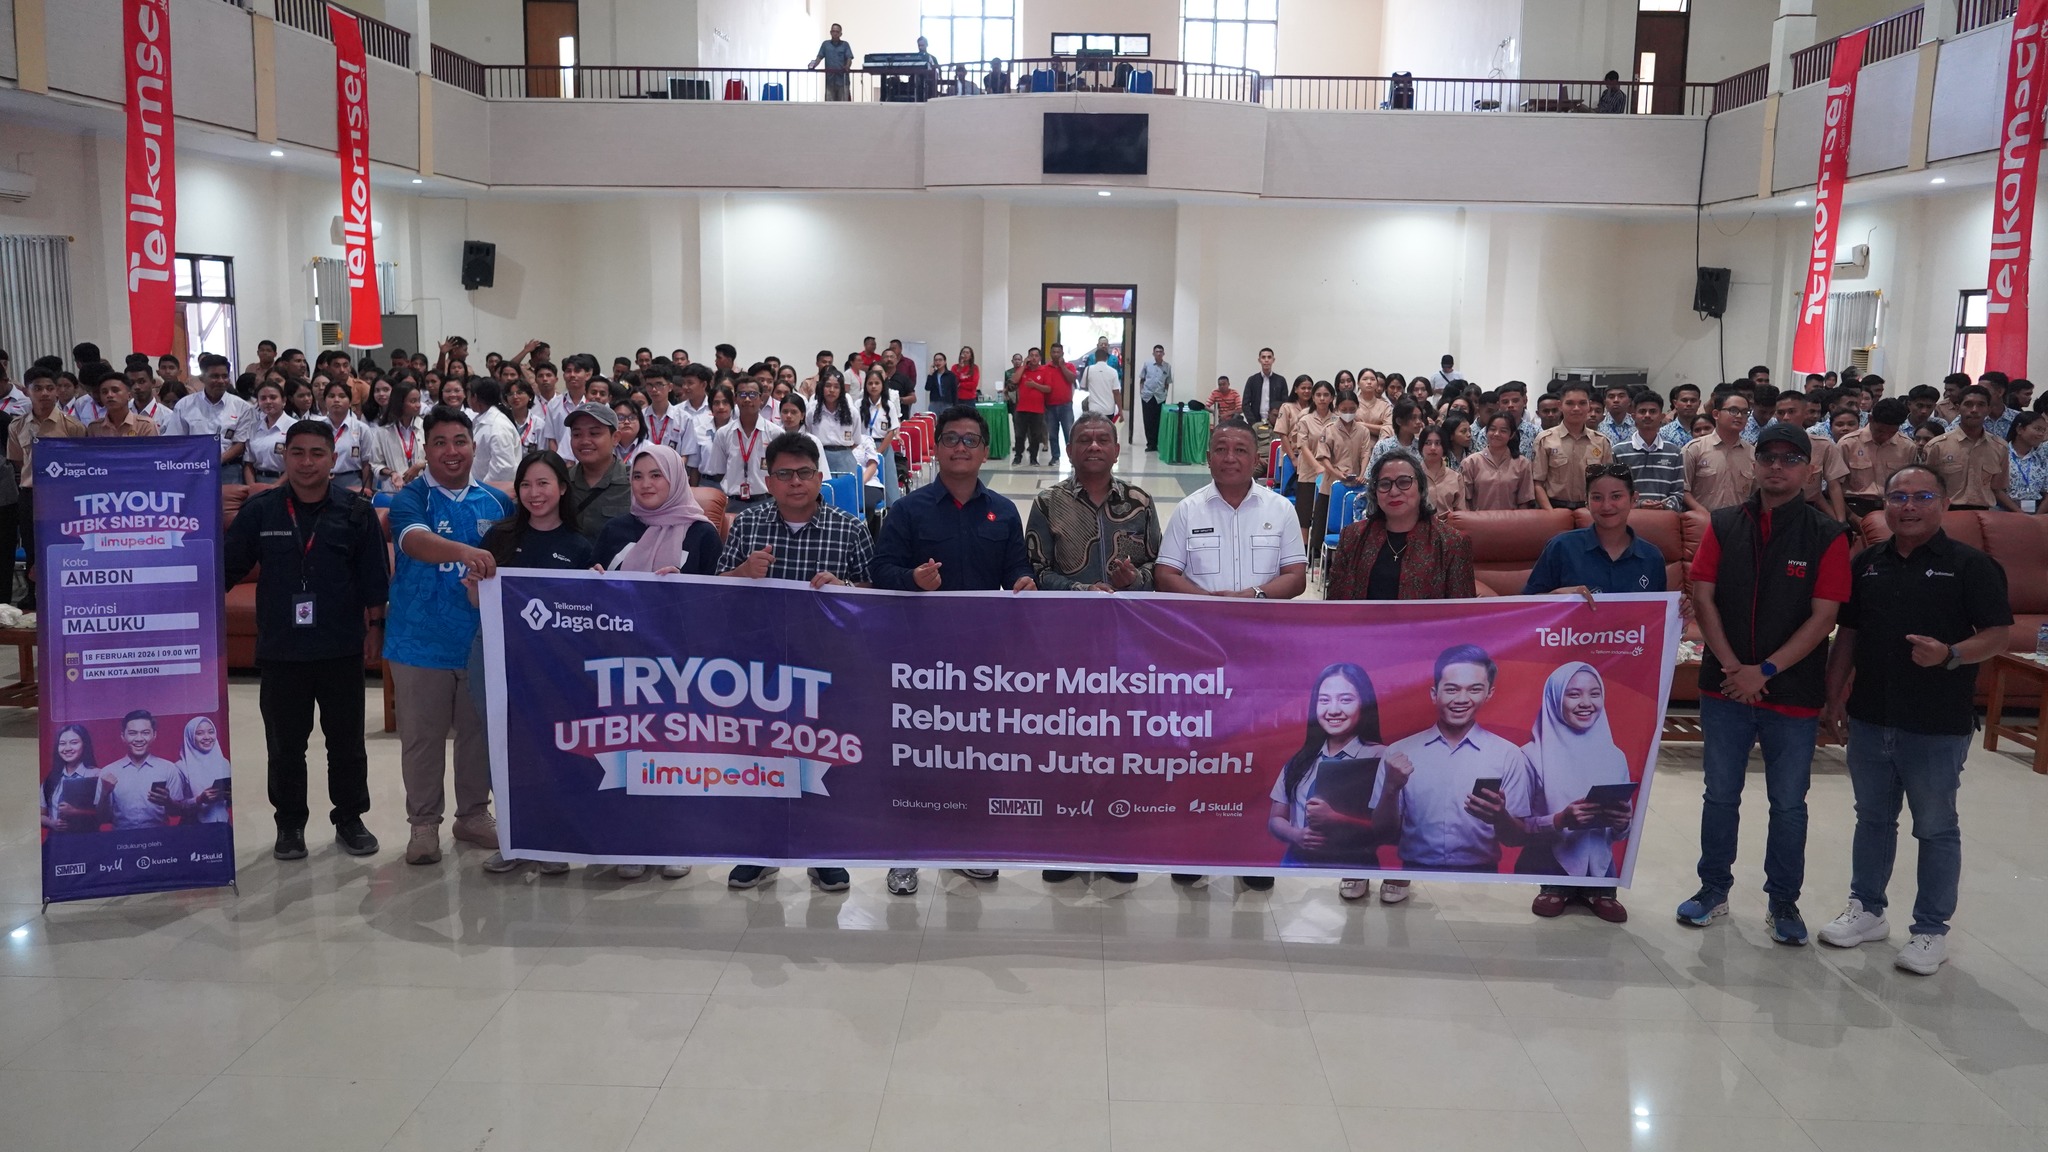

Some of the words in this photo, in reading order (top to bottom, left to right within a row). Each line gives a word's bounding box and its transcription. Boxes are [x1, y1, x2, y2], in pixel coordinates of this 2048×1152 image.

[130, 0, 170, 293] Telkomse
[63, 467, 86, 478] Jaga
[154, 459, 210, 470] Telkomsel
[74, 491, 185, 516] TRYOUT
[60, 515, 107, 536] UTBK
[110, 515, 156, 529] SNBT
[158, 515, 200, 531] 2026
[101, 535, 165, 548] ilmupedia
[62, 558, 89, 567] Kota
[65, 569, 133, 585] AMBON
[1787, 564, 1806, 578] 5G
[64, 603, 117, 616] Provinsi
[554, 602, 593, 611] Telkomsel
[67, 616, 145, 633] MALUKU
[552, 611, 594, 632] Jaga
[1536, 625, 1645, 647] Telkomsel
[162, 649, 182, 657] 09.00
[85, 670, 106, 678] IAKN
[130, 667, 160, 675] AMBON
[891, 660, 966, 691] Raih
[973, 663, 1050, 693] Skor
[1056, 664, 1233, 699] Maksimal,
[583, 656, 832, 719] TRYOUT
[891, 702, 990, 733] Rebut
[997, 706, 1120, 737] Hadiah
[1127, 709, 1212, 738] Total
[554, 714, 657, 751] UTBK
[663, 712, 763, 746] SNBT
[770, 721, 863, 764] 2026
[891, 742, 1032, 772] Puluhan
[1038, 750, 1115, 774] Juta
[1122, 750, 1254, 781] Rupiah!
[641, 758, 785, 792] ilmupedia
[892, 799, 941, 811] Didukung
[942, 801, 968, 810] oleh:
[990, 799, 1041, 815] SIMPATI
[1056, 799, 1094, 817] by.U
[1133, 804, 1176, 813] kuncie
[1208, 802, 1243, 811] Skul.id
[152, 857, 178, 865] kuncie
[56, 863, 86, 876] SIMPATI
